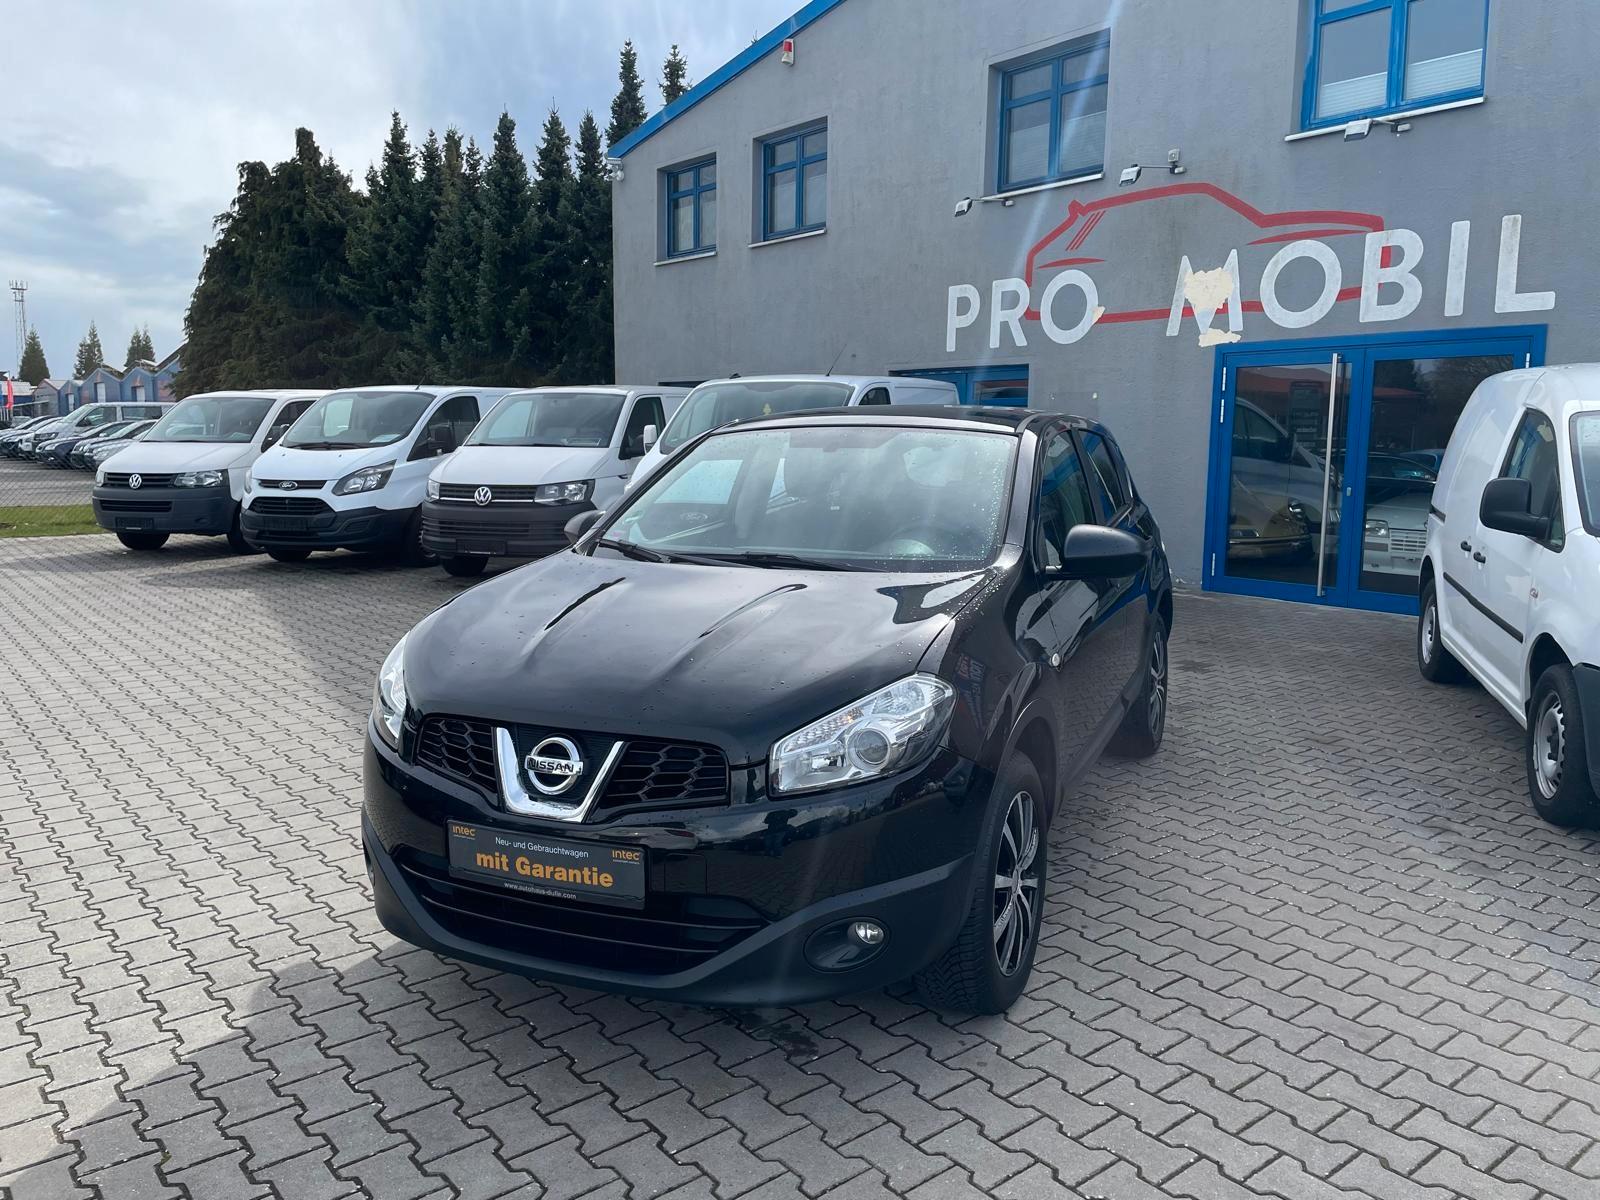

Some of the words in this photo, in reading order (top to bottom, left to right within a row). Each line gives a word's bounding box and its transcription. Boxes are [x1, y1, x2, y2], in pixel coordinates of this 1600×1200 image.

[946, 269, 1100, 352] PRO
[1165, 214, 1556, 337] MOBIL
[526, 757, 576, 773] NISSAN
[495, 836, 512, 847] Neu-
[513, 841, 526, 849] und
[527, 842, 589, 859] Gebrauchtwagen
[476, 851, 509, 872] mit
[515, 855, 614, 888] Garantie
